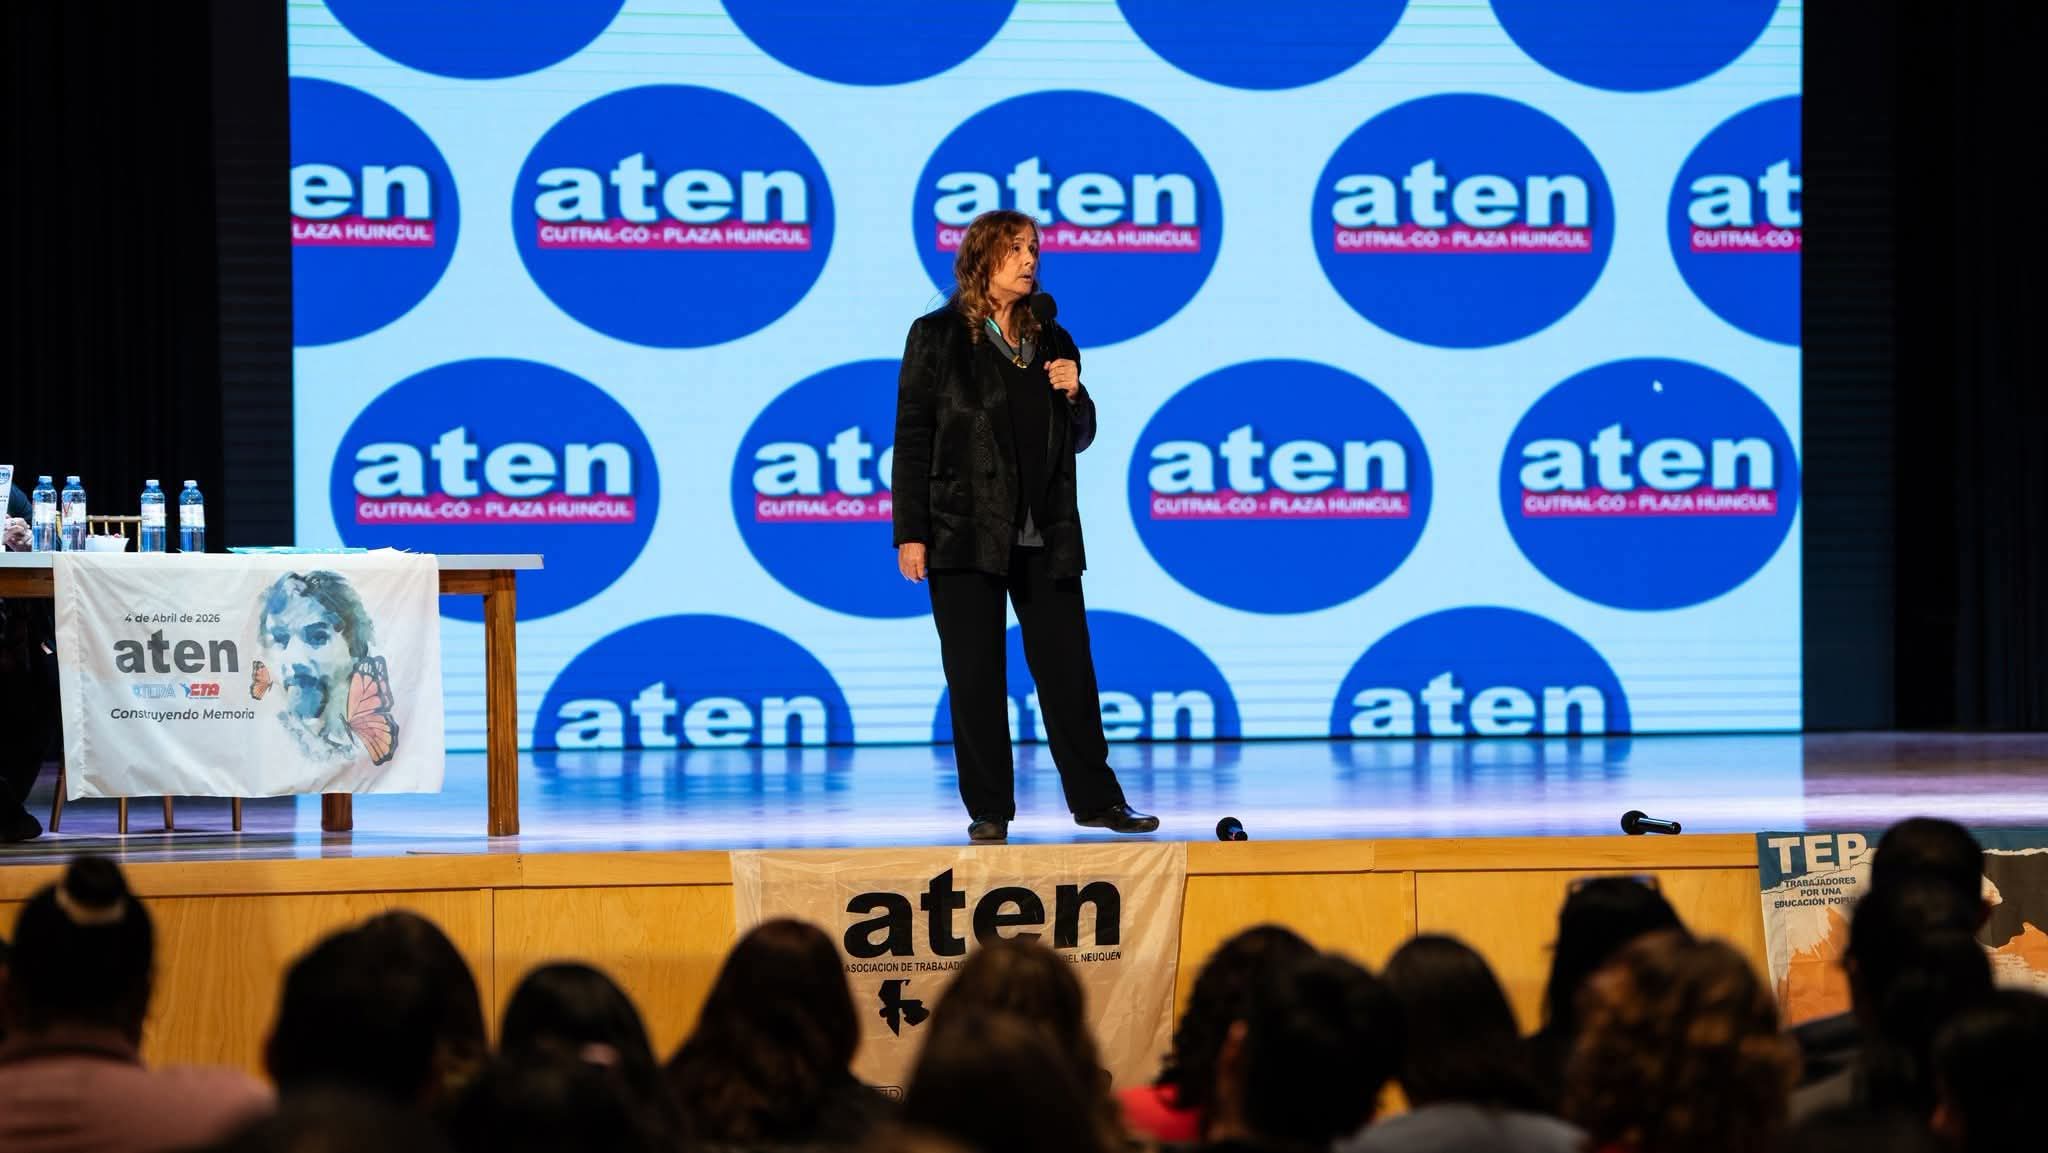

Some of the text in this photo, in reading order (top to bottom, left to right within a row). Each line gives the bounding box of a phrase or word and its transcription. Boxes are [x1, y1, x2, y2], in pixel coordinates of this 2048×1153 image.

[535, 152, 807, 224] aten
[933, 157, 1196, 227] aten
[1332, 159, 1588, 228] aten
[346, 223, 432, 241] HUINCUL
[664, 227, 722, 243] PLAZA
[726, 228, 808, 245] HUINCUL
[1058, 230, 1114, 246] PLAZA
[1117, 230, 1196, 247] HUINCUL
[1452, 231, 1509, 247] PLAZA
[1511, 231, 1588, 248] HUINCUL
[353, 426, 631, 497] aten
[752, 425, 894, 497] at
[1148, 424, 1407, 495] aten
[1520, 423, 1774, 492] aten
[485, 502, 545, 518] PLAZA
[549, 502, 631, 518] HUINCUL
[1270, 498, 1325, 513] PLAZA
[1328, 497, 1407, 514] HUINCUL
[1638, 495, 1693, 511] PLAZA
[1697, 494, 1773, 511] HUINCUL
[125, 613, 221, 623] 4 de Abril de 2026
[113, 628, 239, 674] aten
[110, 708, 255, 723] Construyendo Memoria
[555, 681, 827, 748] aten
[1350, 672, 1605, 736] aten
[1768, 833, 1867, 874] TEP
[1784, 877, 1857, 888] TRABAJADORES
[1800, 888, 1842, 897] POR UNA
[843, 868, 1121, 959] aten
[901, 963, 912, 972] DE
